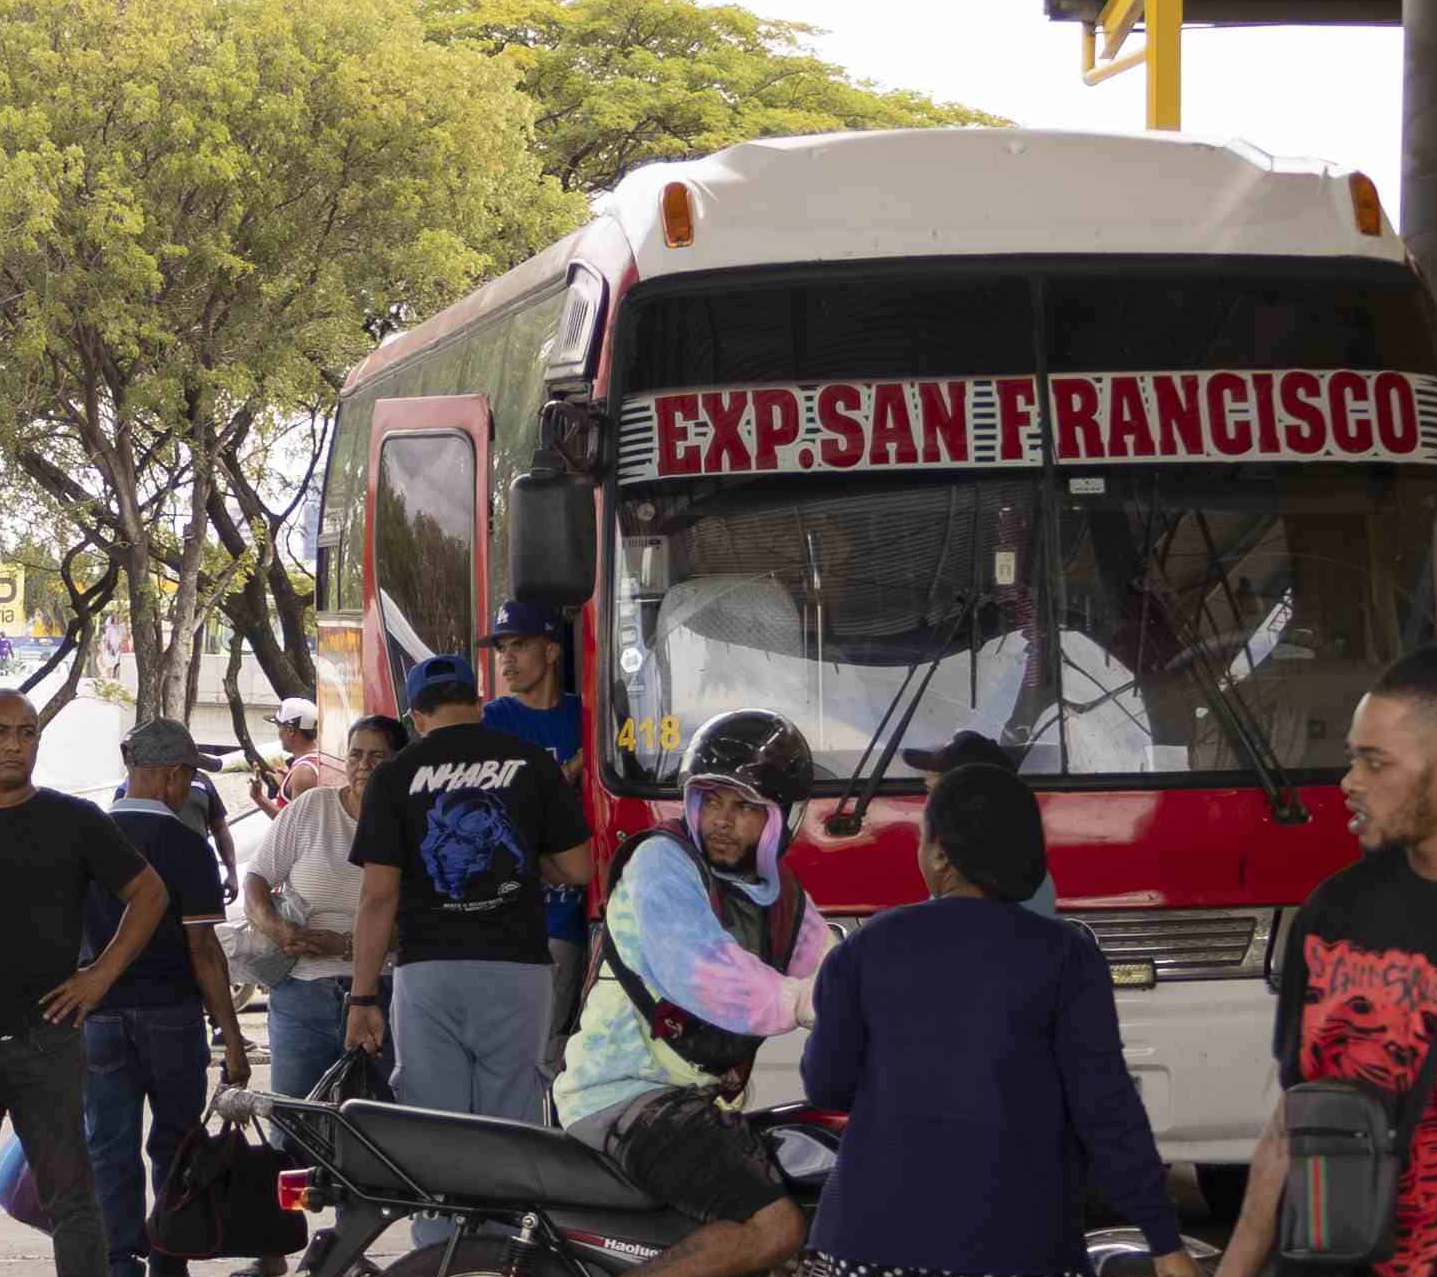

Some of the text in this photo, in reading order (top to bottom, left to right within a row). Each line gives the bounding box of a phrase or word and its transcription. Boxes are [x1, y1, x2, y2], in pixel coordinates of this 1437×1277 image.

[995, 370, 1418, 461] FRANCISCO
[617, 714, 680, 752] 418
[408, 759, 528, 796] INHABIT
